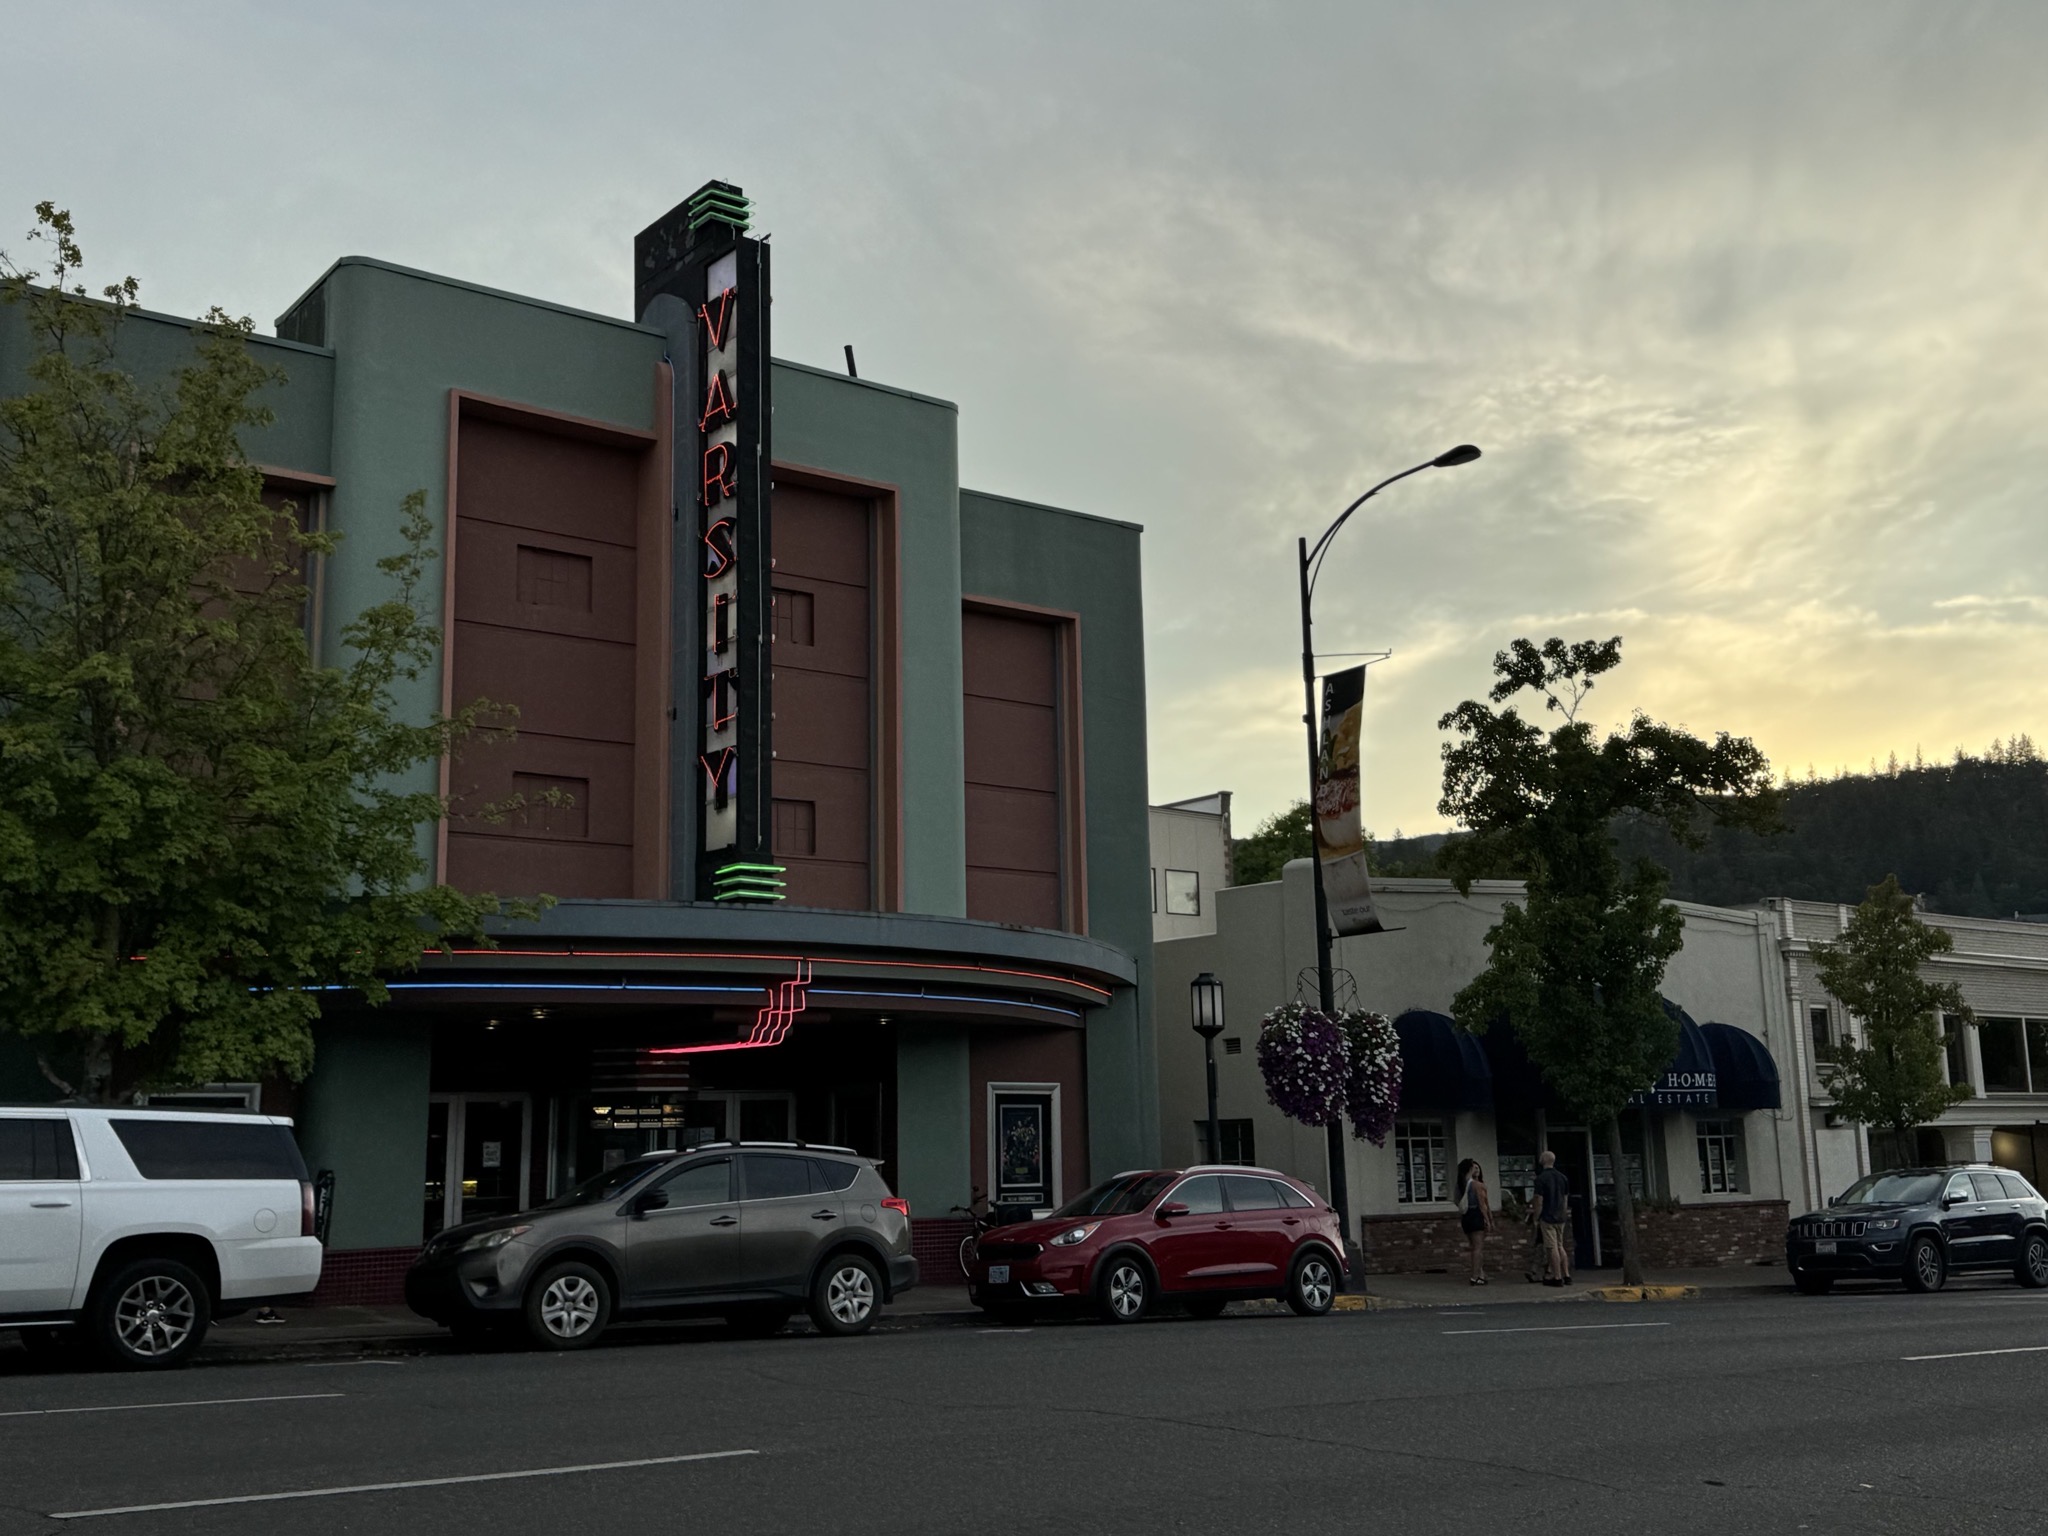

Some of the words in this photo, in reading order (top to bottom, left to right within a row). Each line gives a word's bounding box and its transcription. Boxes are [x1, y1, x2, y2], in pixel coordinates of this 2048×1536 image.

[698, 286, 738, 812] VARSITY
[1319, 683, 1334, 797] ASHLAND
[1658, 1094, 1708, 1104] ESTATE
